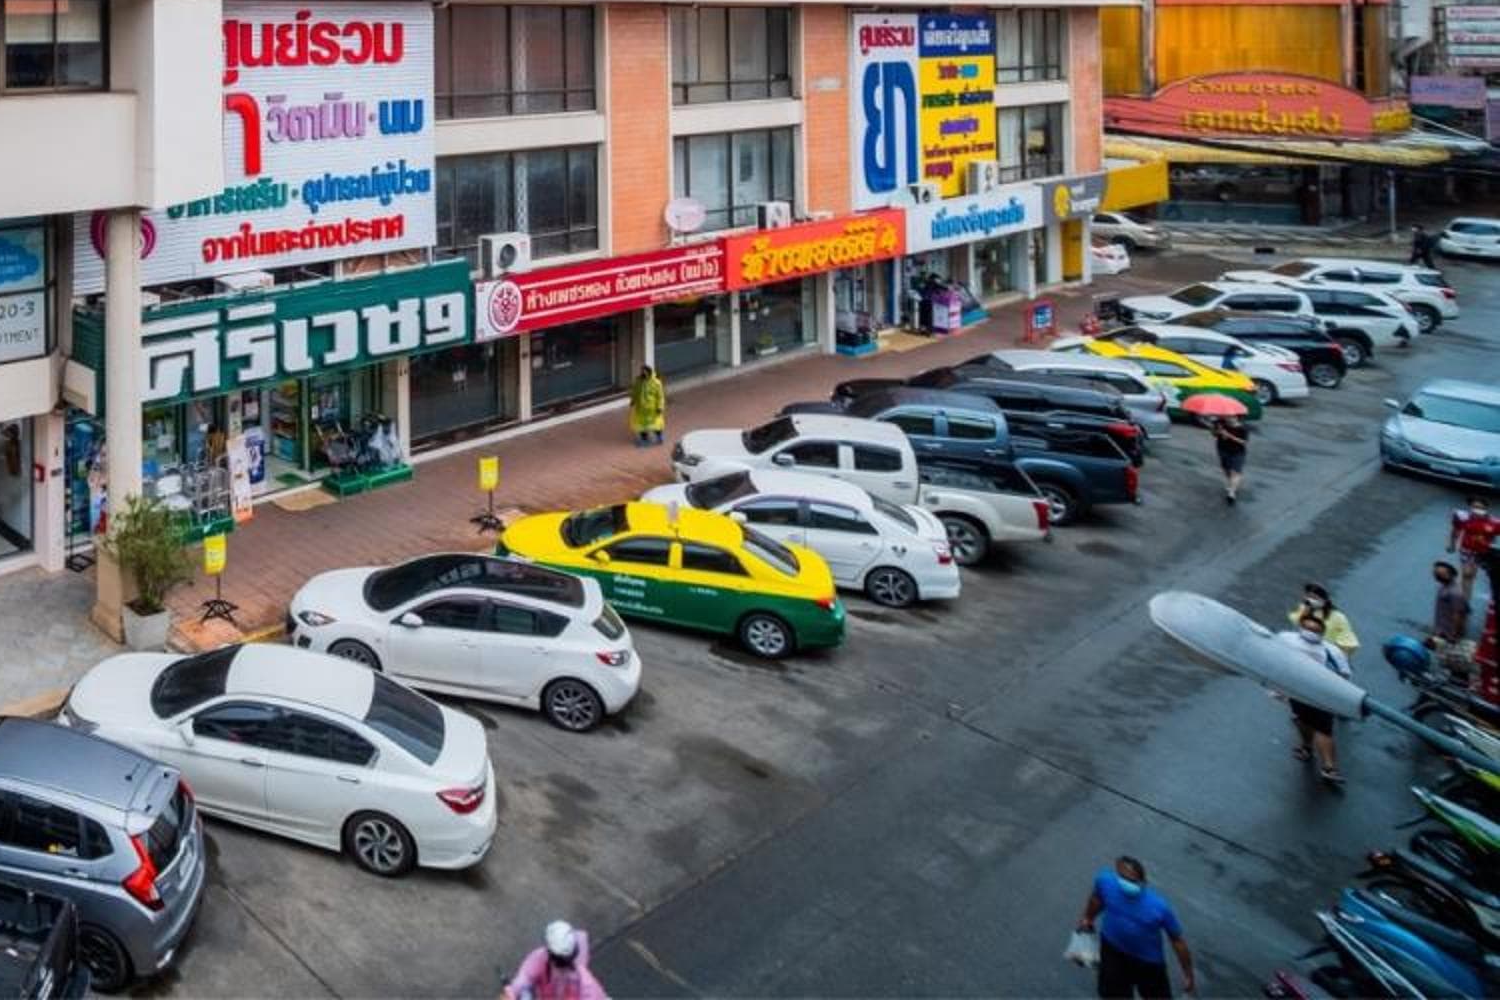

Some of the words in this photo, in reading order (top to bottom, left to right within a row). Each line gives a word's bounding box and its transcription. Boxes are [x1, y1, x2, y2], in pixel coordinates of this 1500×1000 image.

[266, 92, 366, 143] วิตามิน
[379, 99, 424, 134] นม
